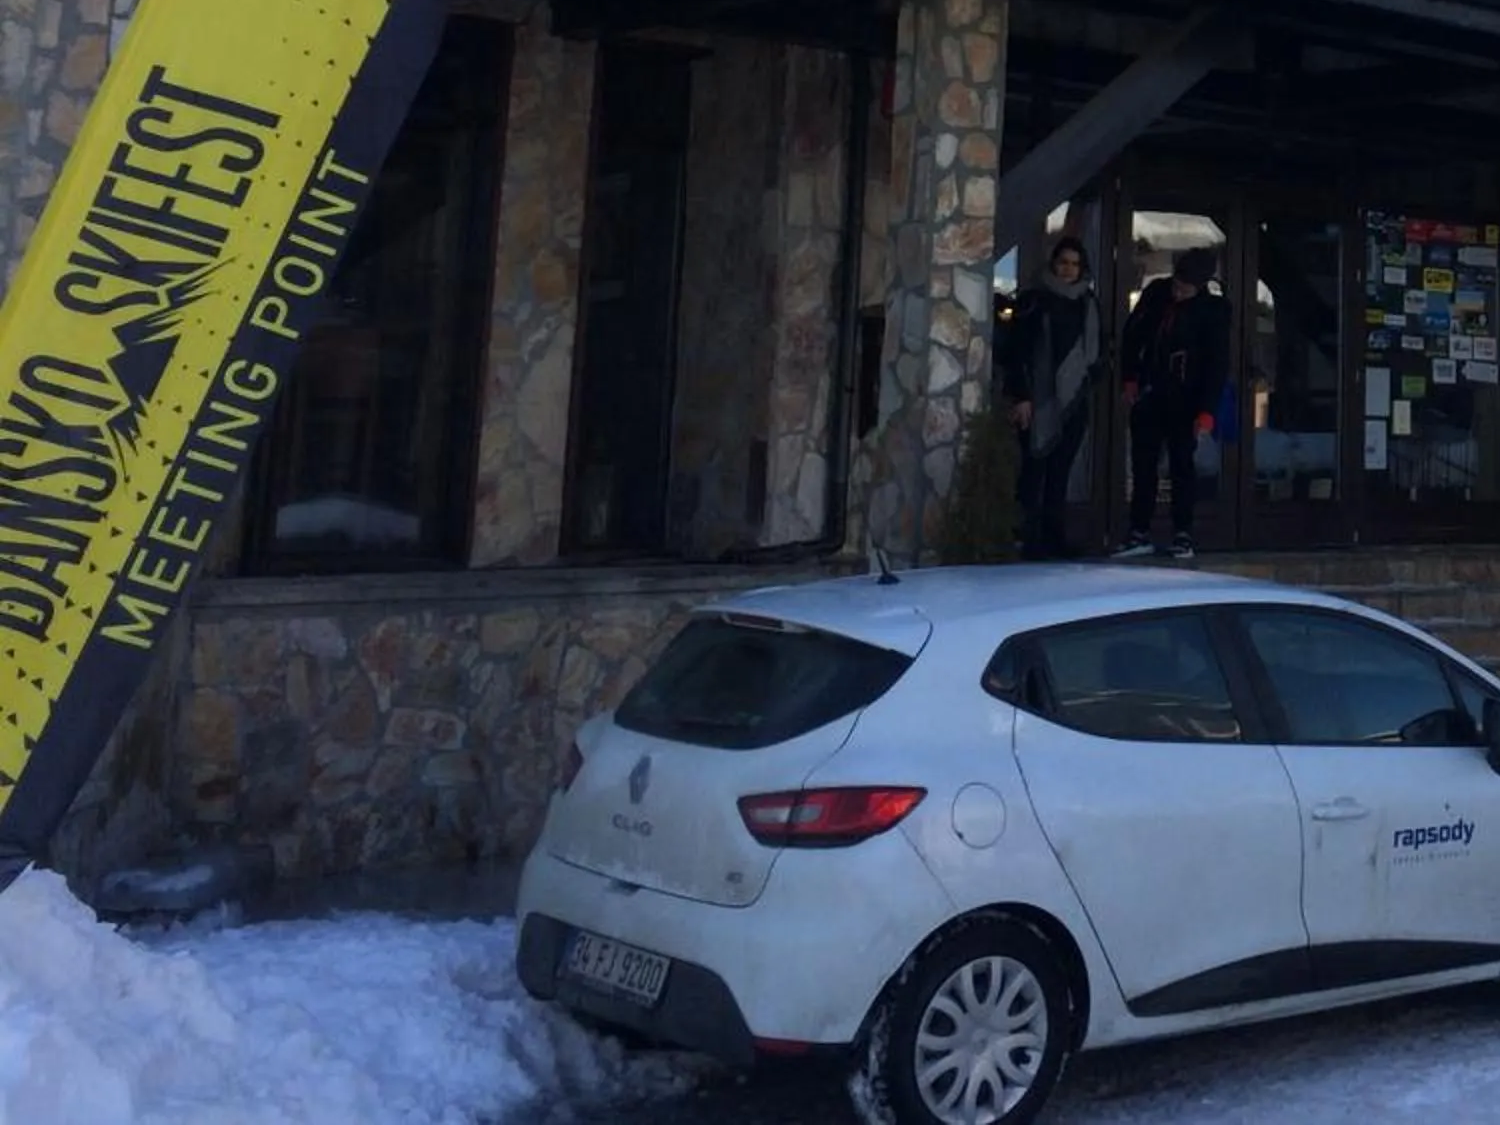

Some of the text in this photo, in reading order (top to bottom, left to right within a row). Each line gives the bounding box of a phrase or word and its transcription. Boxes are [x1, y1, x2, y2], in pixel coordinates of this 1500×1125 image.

[54, 65, 283, 316] SKIFEST
[101, 148, 370, 649] MEETING POINT
[1393, 818, 1475, 850] rapsody
[619, 951, 664, 994] 9200
